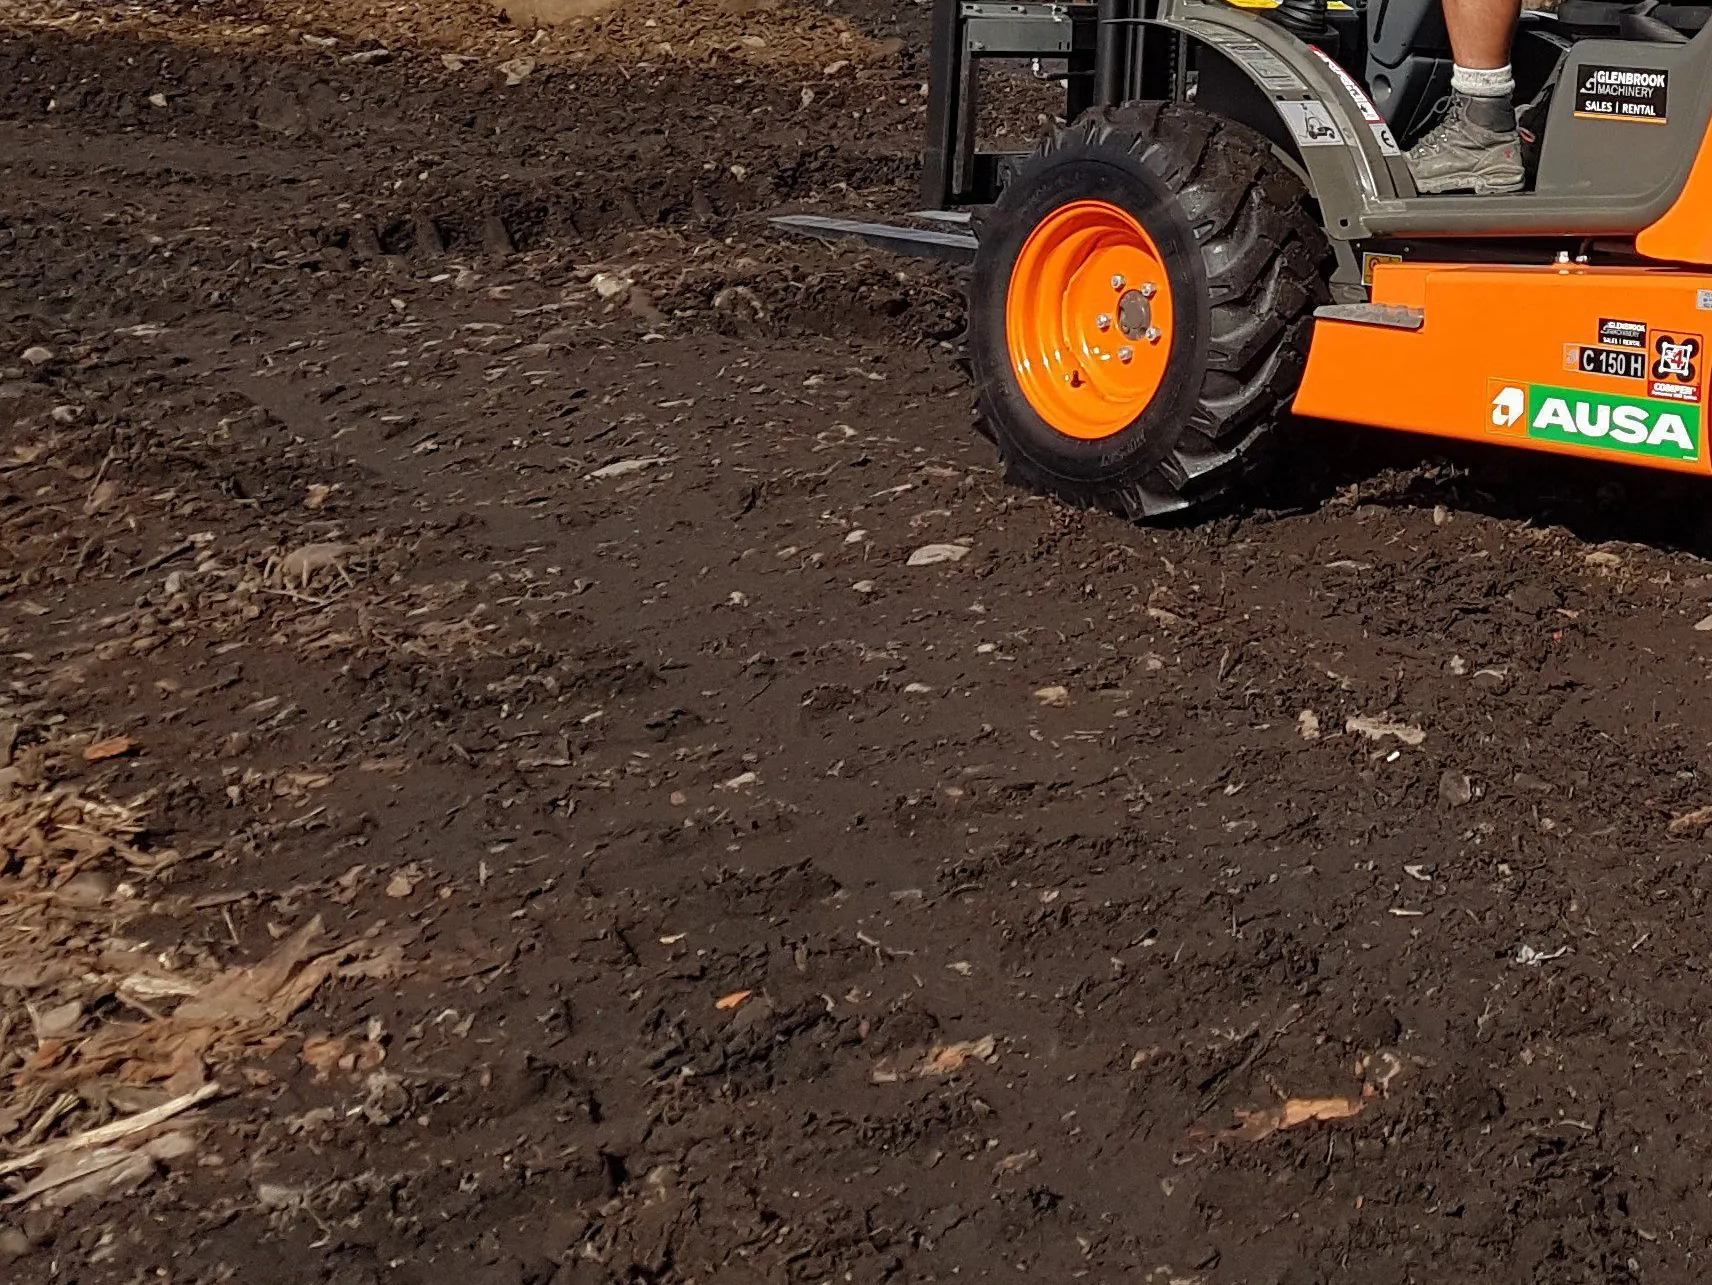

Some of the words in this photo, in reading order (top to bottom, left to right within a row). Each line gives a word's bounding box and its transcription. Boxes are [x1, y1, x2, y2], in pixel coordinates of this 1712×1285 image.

[1597, 70, 1666, 88] GLENBROOK
[1597, 83, 1655, 98] MACHINERY
[1585, 100, 1613, 112] SALES
[1622, 103, 1656, 116] RENTAL
[1583, 349, 1594, 370] C
[1600, 352, 1626, 375] 150
[1630, 354, 1642, 377] H
[1532, 397, 1694, 450] AUSA
